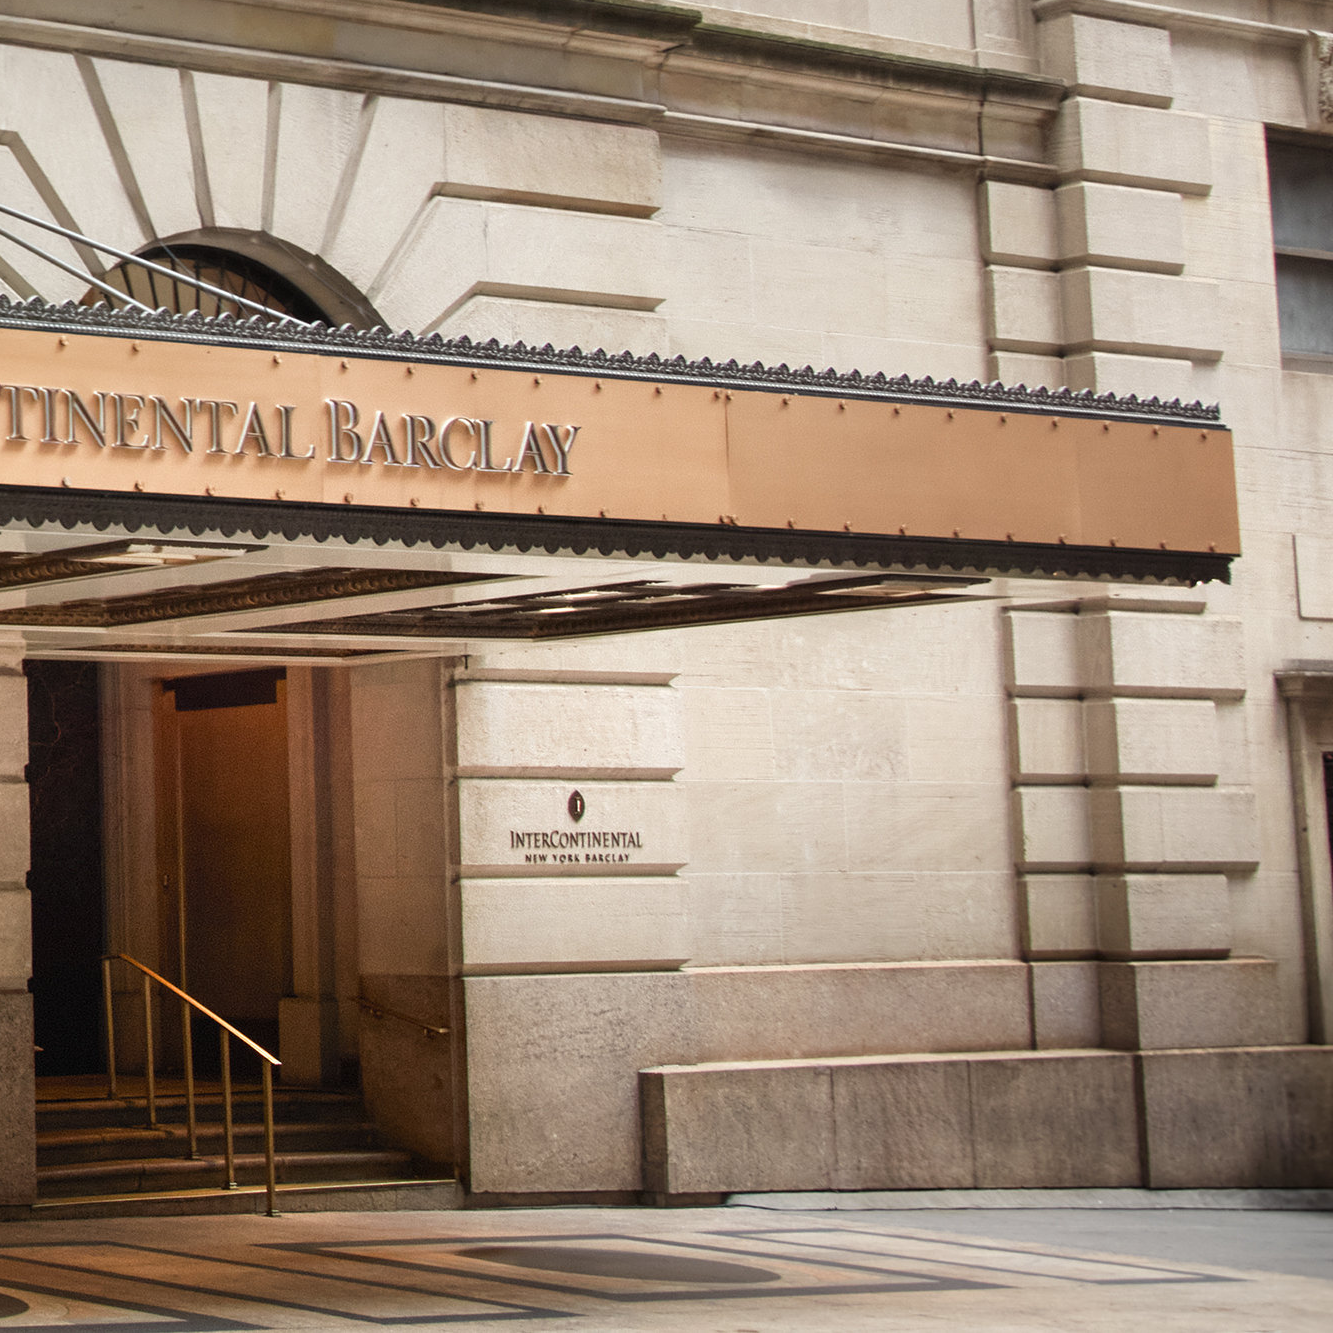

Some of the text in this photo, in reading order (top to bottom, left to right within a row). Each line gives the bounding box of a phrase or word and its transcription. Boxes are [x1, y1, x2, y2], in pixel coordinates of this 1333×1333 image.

[324, 397, 582, 477] BARCLAY
[510, 829, 644, 849] INTERCONTINENTAL
[525, 853, 630, 863] NEW YORK BARCLAY
